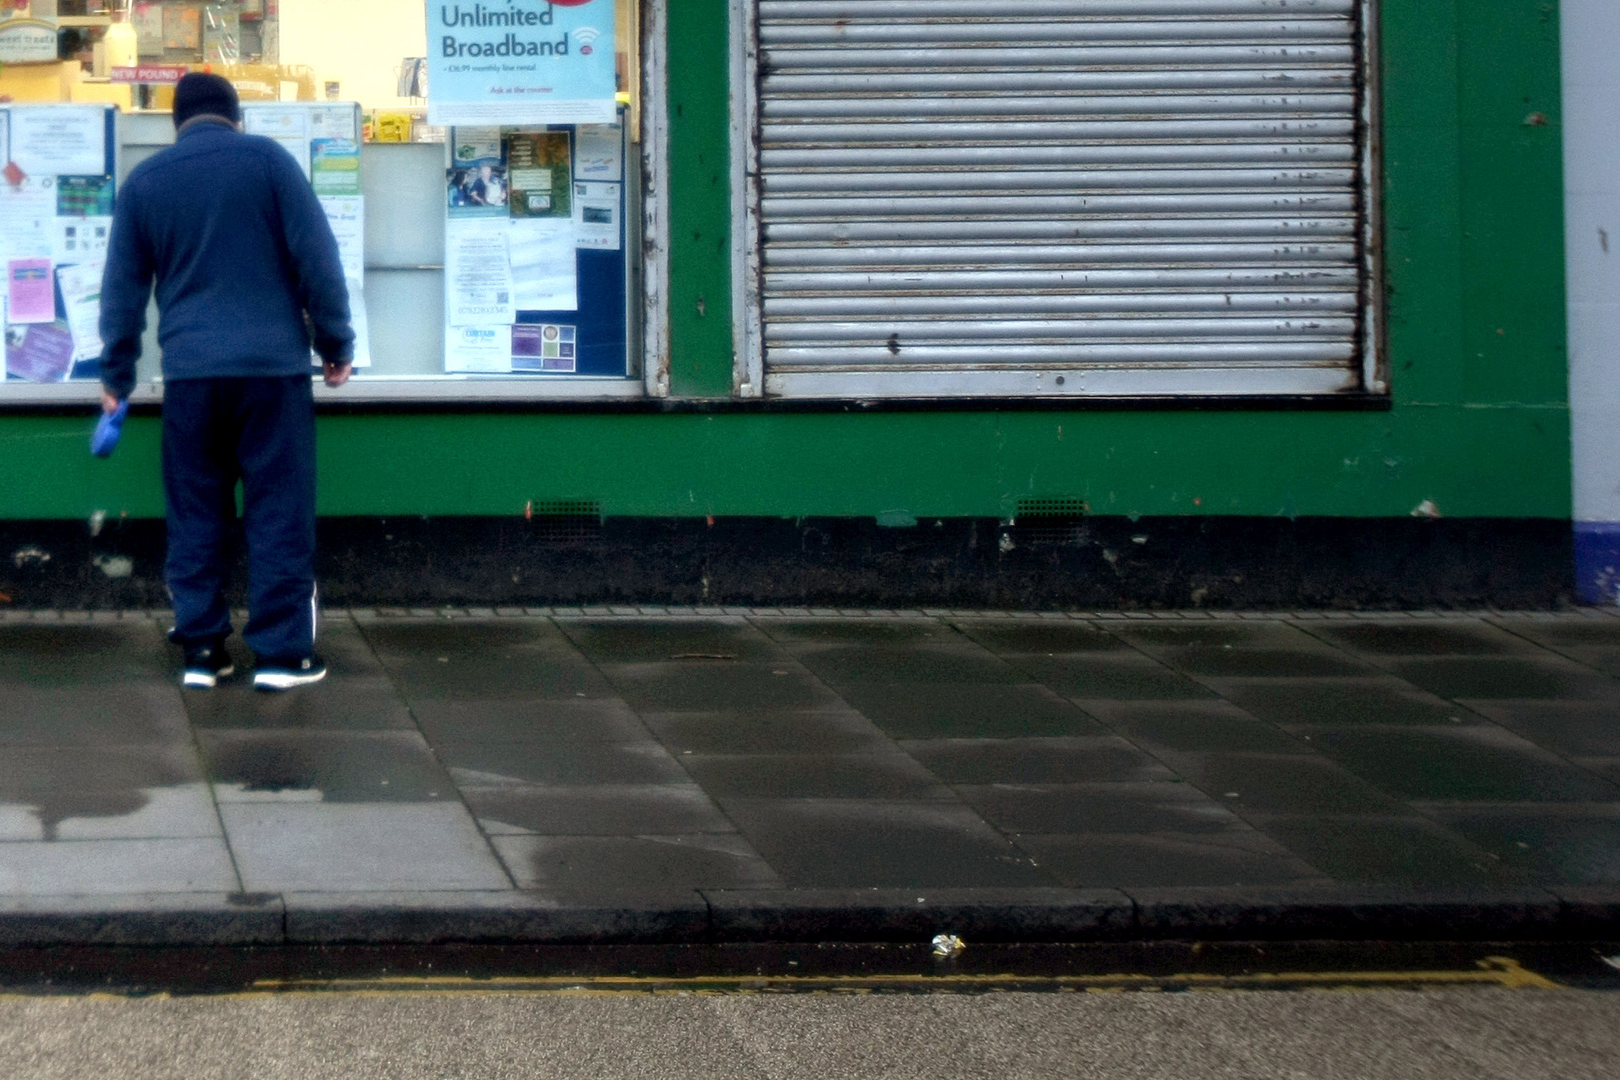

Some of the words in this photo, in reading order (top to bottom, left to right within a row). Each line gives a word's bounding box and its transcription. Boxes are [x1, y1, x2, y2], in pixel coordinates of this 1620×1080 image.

[442, 2, 554, 27] Unlimited
[442, 32, 569, 58] Broadband
[138, 69, 179, 80] POUND
